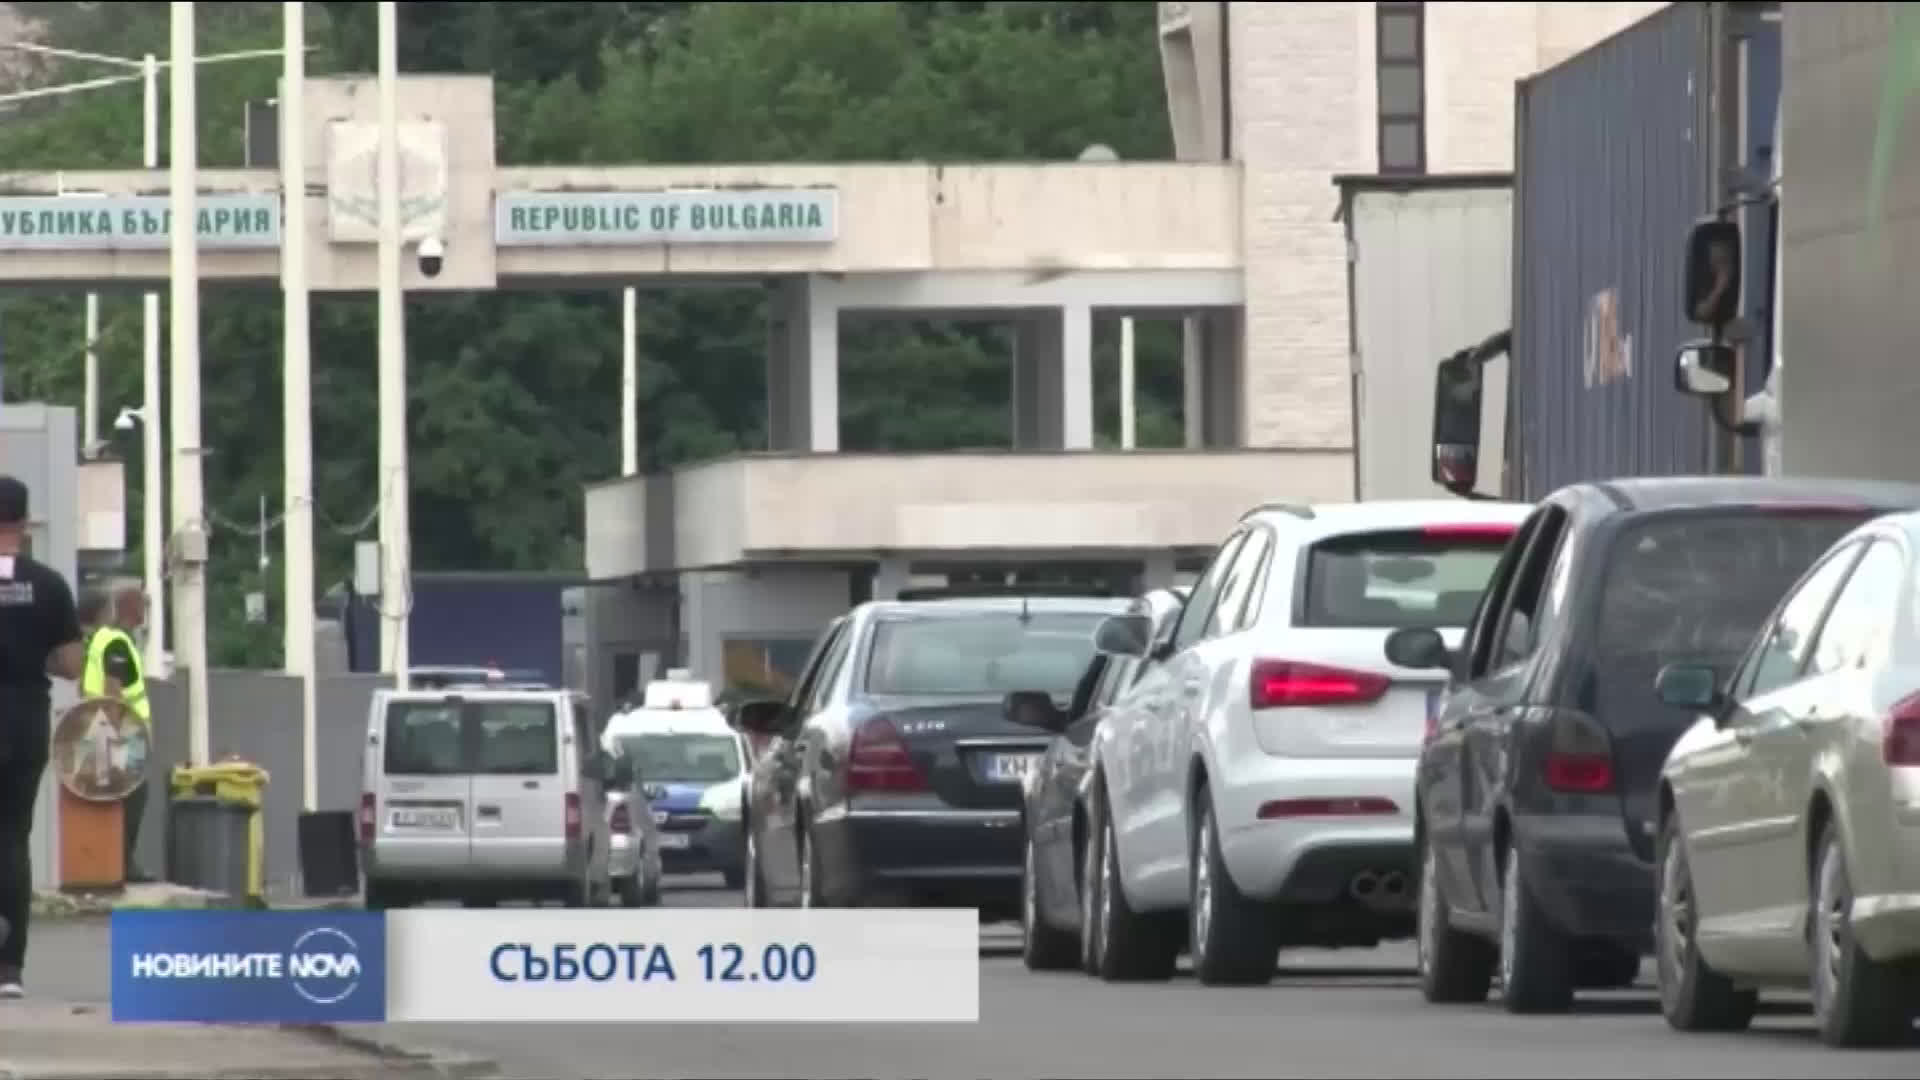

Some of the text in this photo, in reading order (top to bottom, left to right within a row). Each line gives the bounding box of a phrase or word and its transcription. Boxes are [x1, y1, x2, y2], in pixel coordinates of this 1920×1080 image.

[122, 208, 271, 235] БЪЛАРИЯ
[511, 203, 824, 231] REPUBLIC OF BULGARIA
